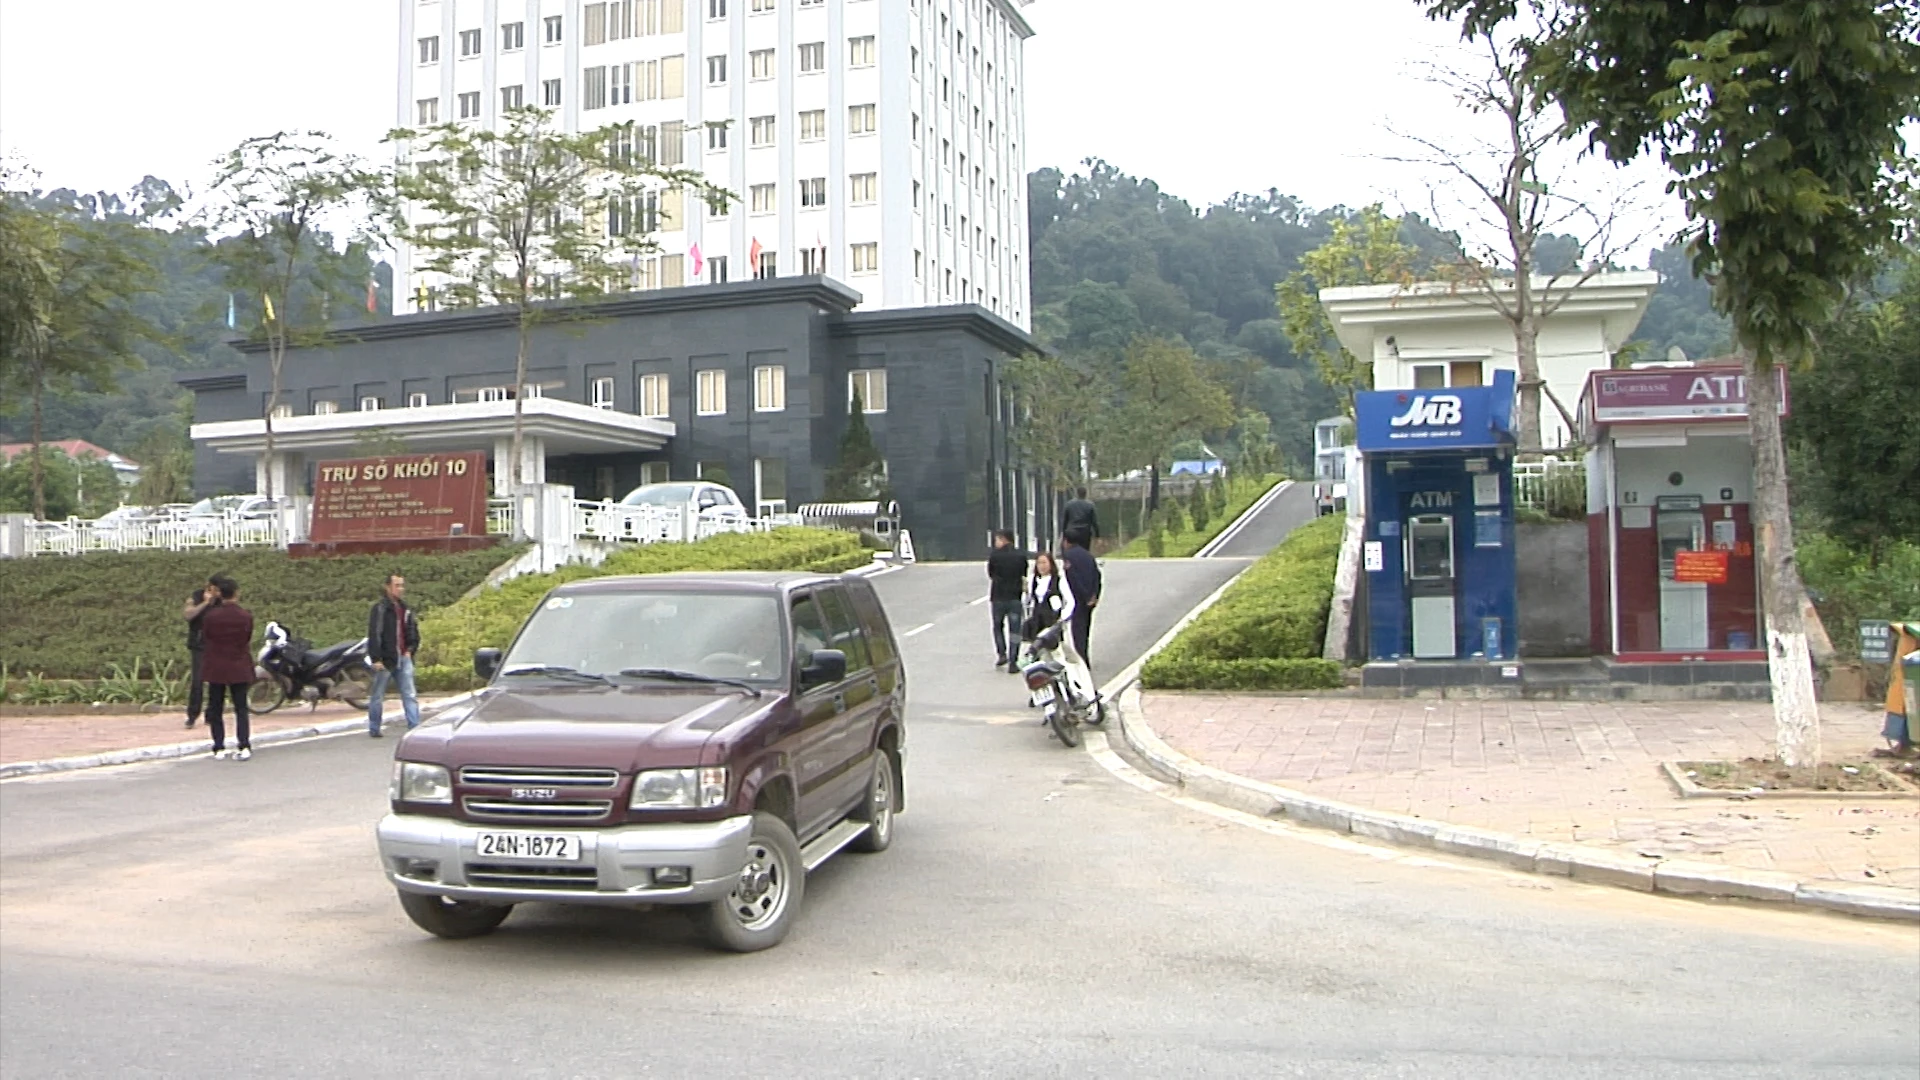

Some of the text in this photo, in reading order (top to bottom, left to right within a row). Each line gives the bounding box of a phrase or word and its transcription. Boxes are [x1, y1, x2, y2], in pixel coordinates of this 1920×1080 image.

[1391, 395, 1462, 426] MB
[446, 459, 467, 476] 10
[1410, 491, 1452, 508] ATM
[511, 788, 556, 798] ISUZU
[483, 835, 567, 857] 24N-1872
